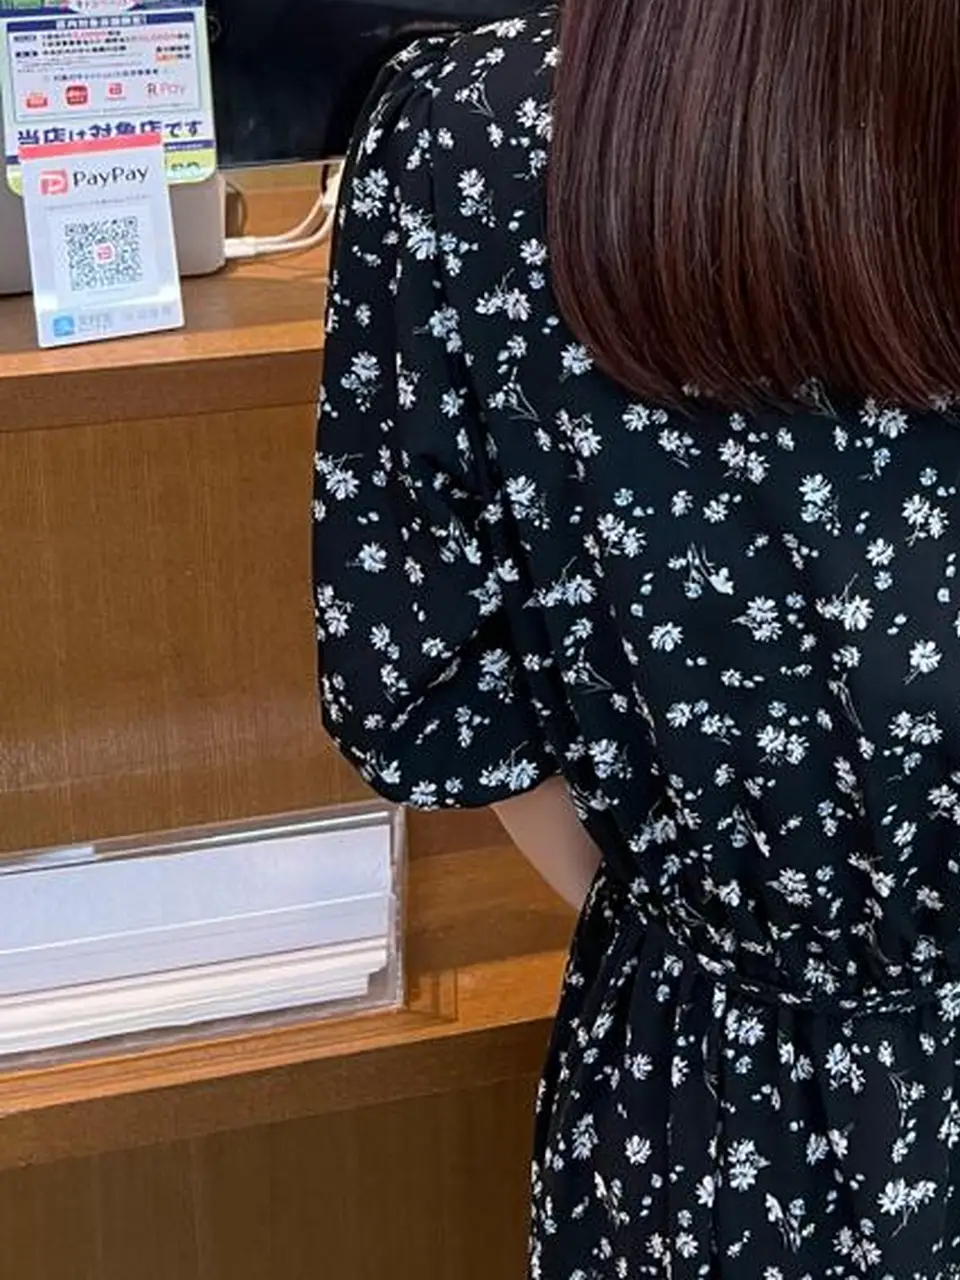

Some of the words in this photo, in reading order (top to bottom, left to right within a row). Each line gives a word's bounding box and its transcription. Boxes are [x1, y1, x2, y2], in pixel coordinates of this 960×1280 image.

[17, 120, 203, 146] 当店は対象店です
[72, 165, 150, 189] PayPay
